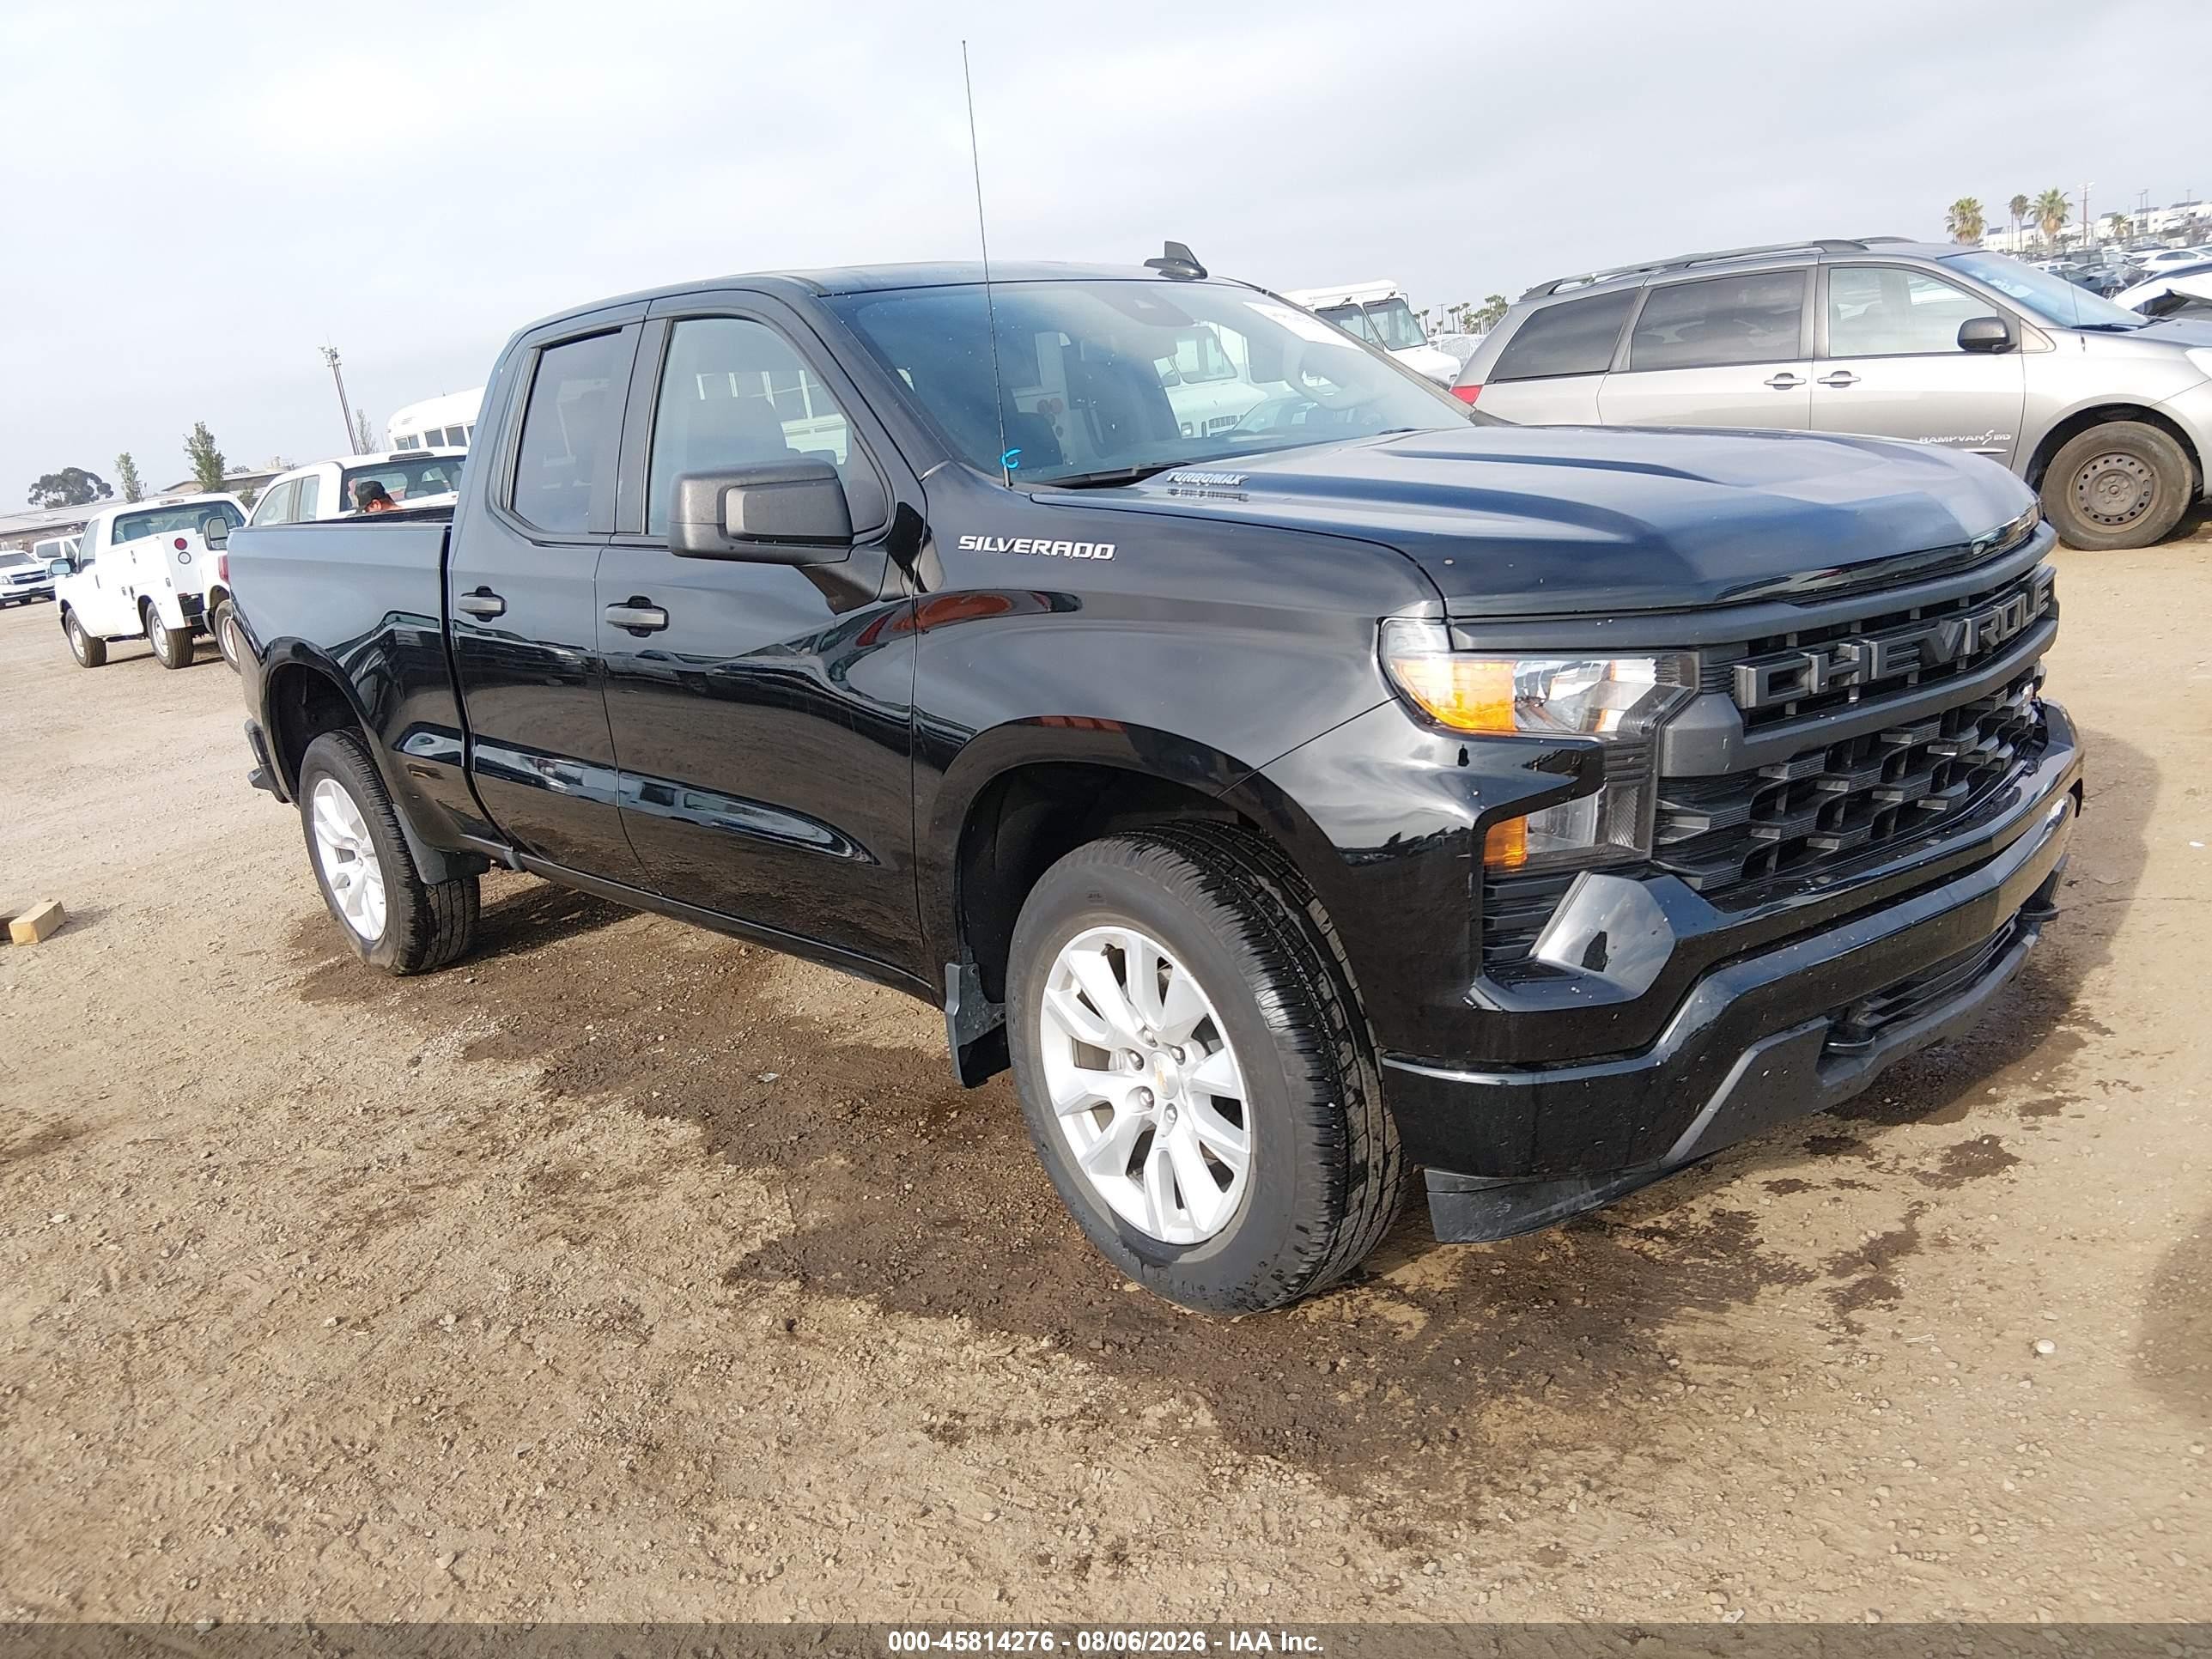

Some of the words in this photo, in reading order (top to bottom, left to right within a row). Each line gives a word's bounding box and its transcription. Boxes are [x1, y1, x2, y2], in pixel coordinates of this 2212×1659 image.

[1167, 471, 1249, 486] TURBOMAX
[957, 535, 1116, 562] SILVERADO
[1734, 562, 2057, 709] CHEVROLE
